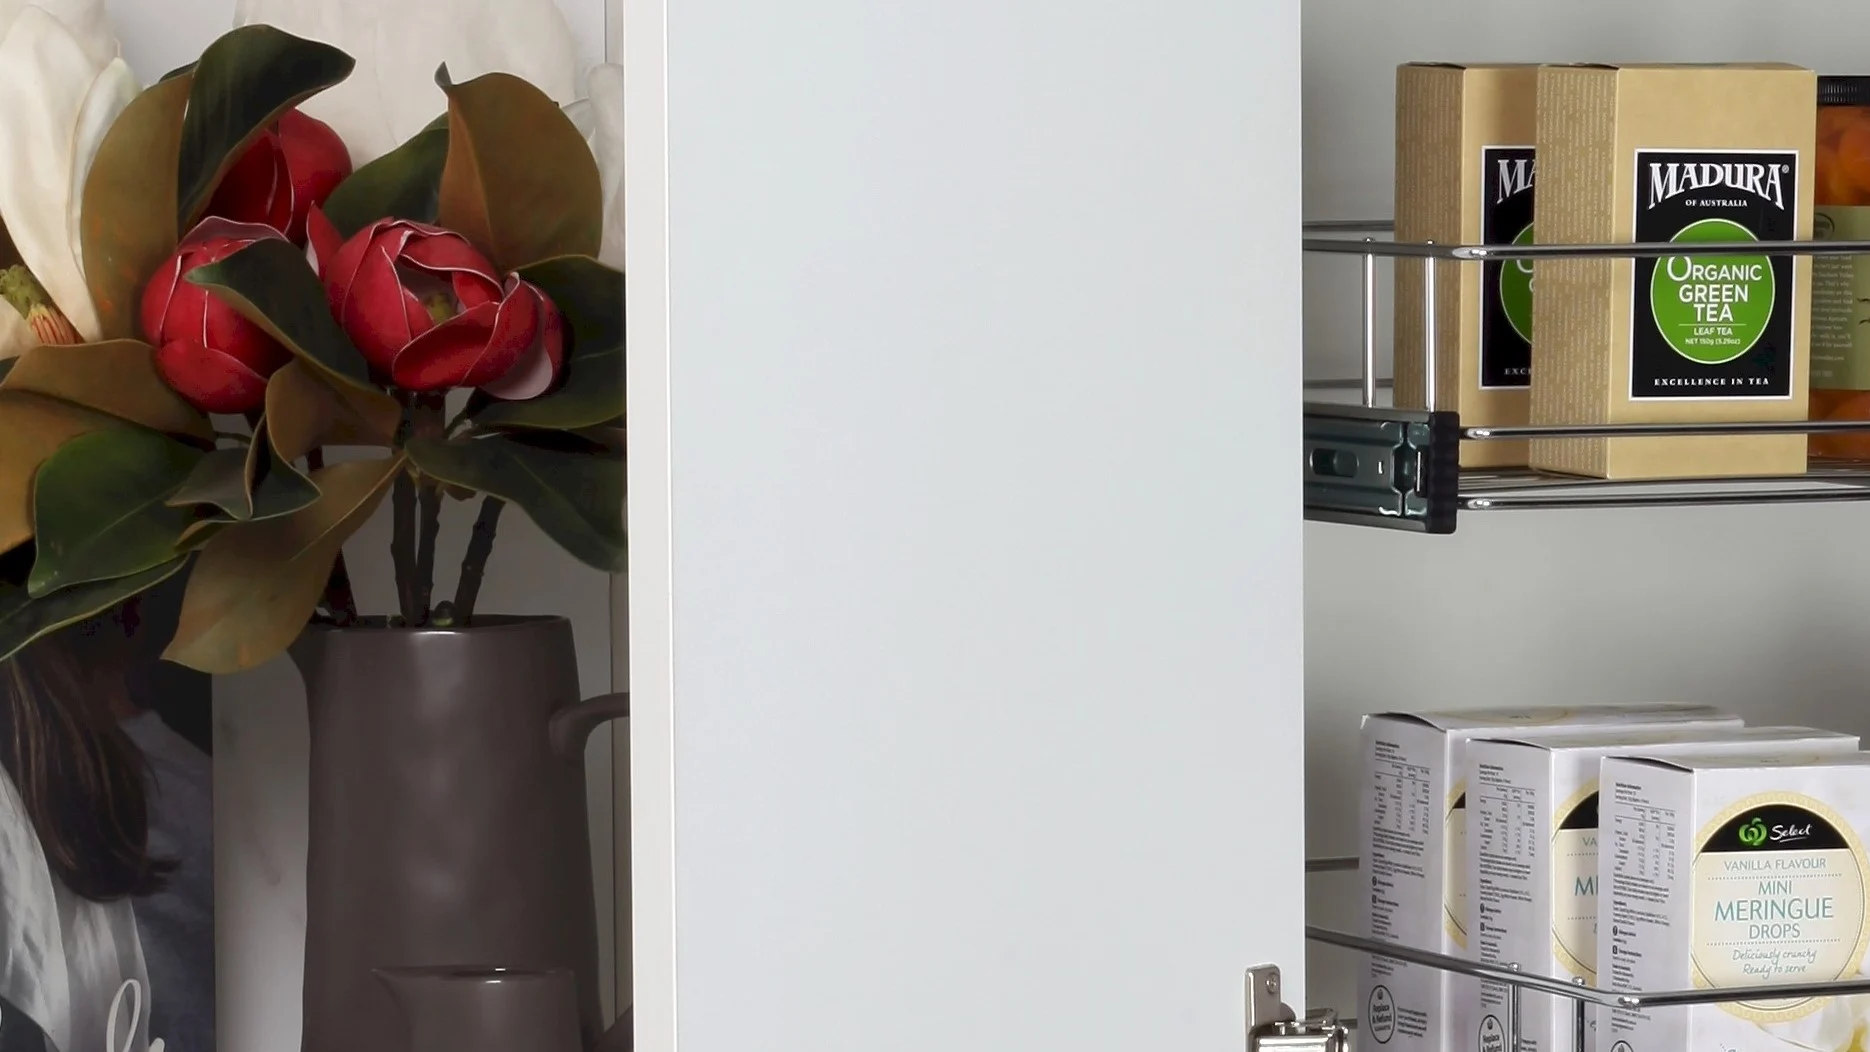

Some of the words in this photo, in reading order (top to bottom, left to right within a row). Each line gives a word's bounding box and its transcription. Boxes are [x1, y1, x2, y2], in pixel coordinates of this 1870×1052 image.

[1667, 256, 1762, 282] ORGANIC
[1679, 285, 1749, 302] GREEN
[1694, 304, 1733, 322] TEA
[1694, 328, 1715, 336] LEAF
[1717, 328, 1733, 336] TEA
[1769, 824, 1812, 842] Select
[1724, 860, 1772, 871] VANILLA
[1775, 858, 1826, 870] FLAVOUR
[1758, 880, 1792, 895] MINI
[1715, 898, 1834, 921] MERINGUE
[1749, 923, 1800, 940] DROPS
[1732, 949, 1781, 965] Deliciously
[1782, 949, 1817, 964] crunchy
[1743, 964, 1773, 980] Ready
[1774, 963, 1783, 973] to
[1784, 965, 1806, 973] serve
